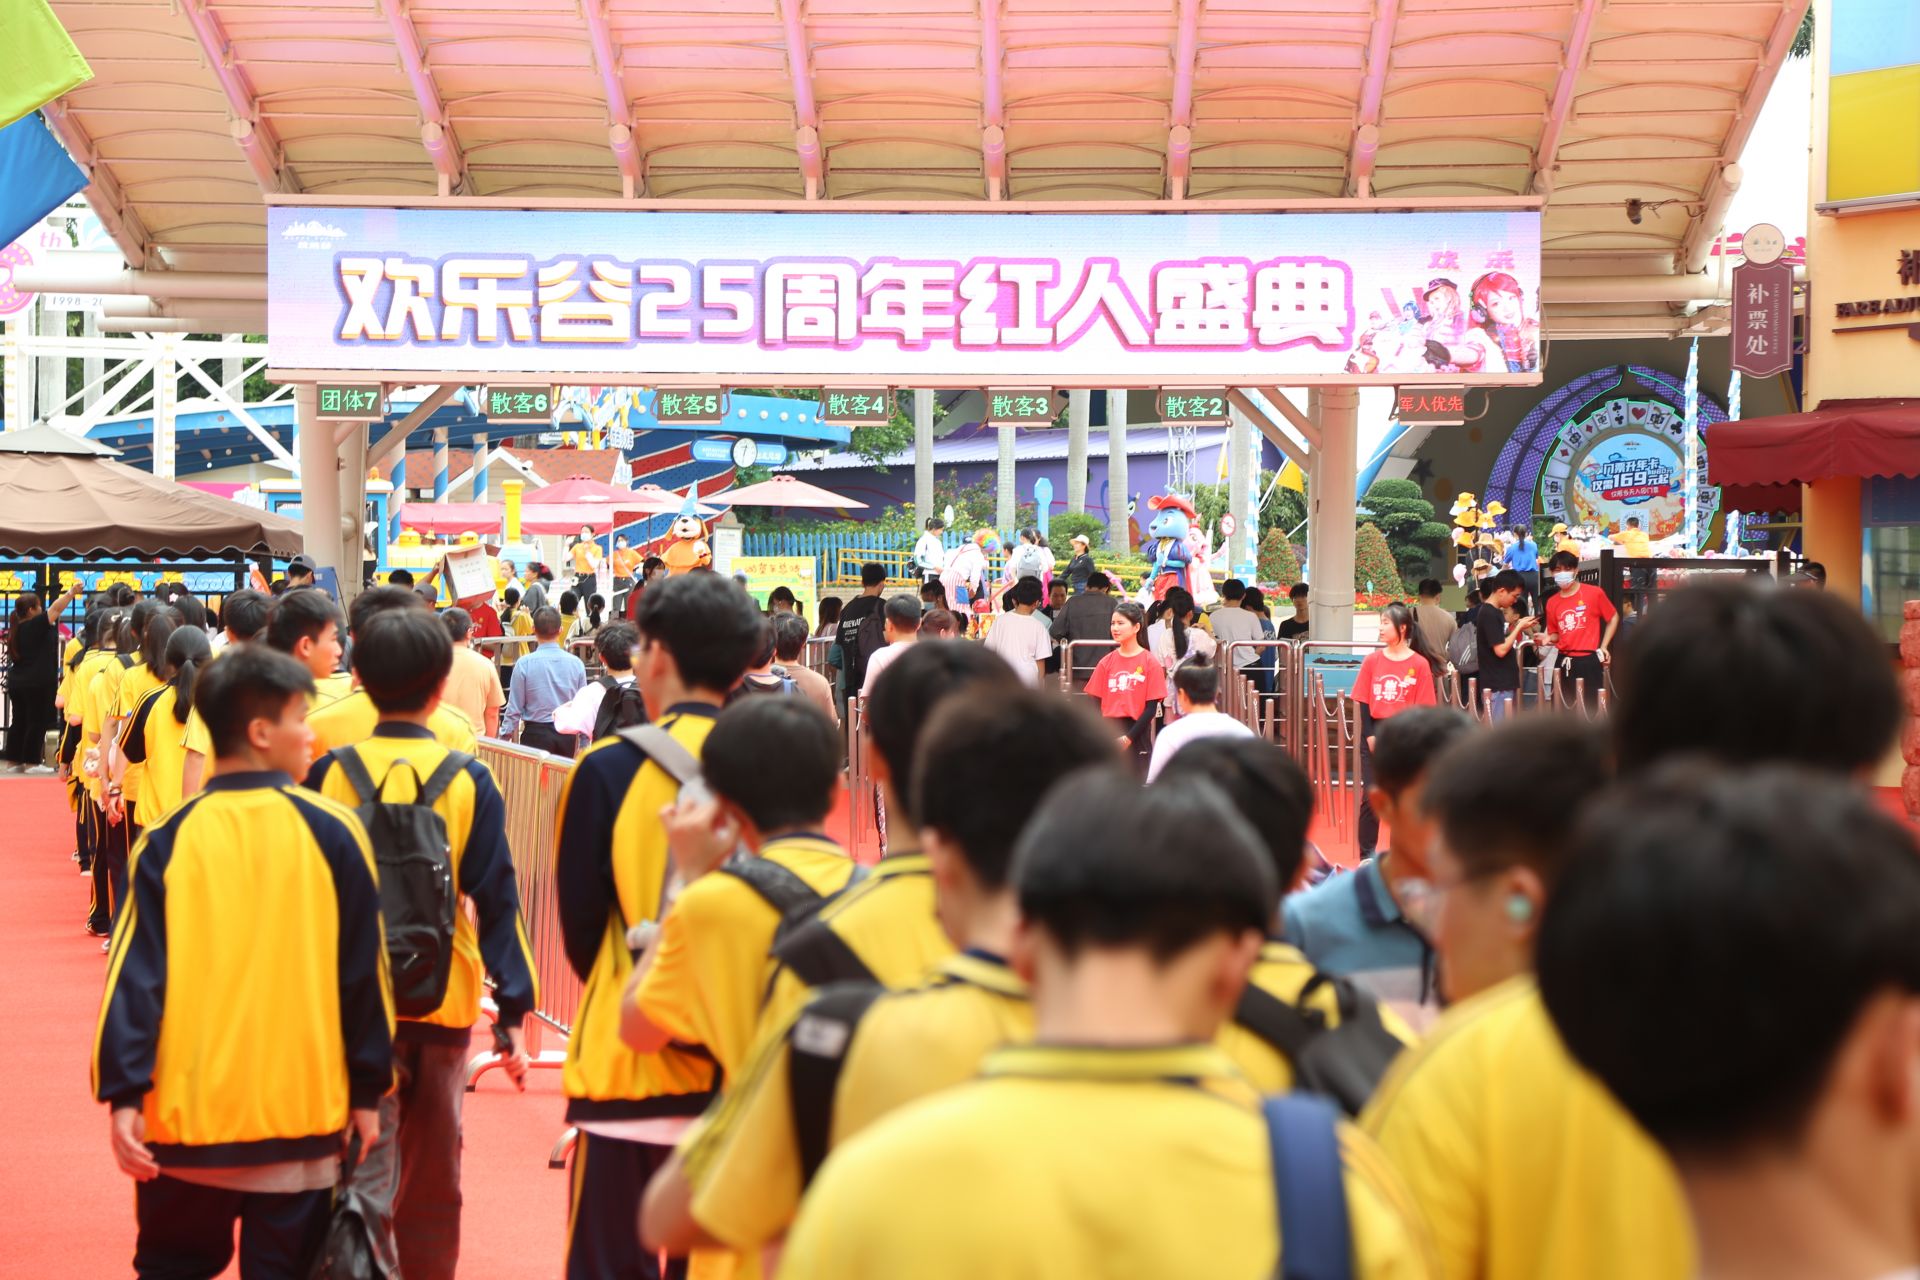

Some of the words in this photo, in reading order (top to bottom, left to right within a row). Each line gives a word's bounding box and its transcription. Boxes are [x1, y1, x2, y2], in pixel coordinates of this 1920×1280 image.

[337, 254, 1352, 350] 欢乐谷25周年红人盛典
[1746, 283, 1769, 356] 补票处
[321, 389, 378, 412] 团体7
[490, 391, 548, 414] 散客6
[660, 393, 718, 416] 散客5
[828, 393, 884, 416] 散客4
[992, 394, 1049, 418] 散客3
[1165, 395, 1223, 418] 散客2
[1400, 395, 1463, 412] 军人优先
[1592, 471, 1670, 491] 仅需169元起
